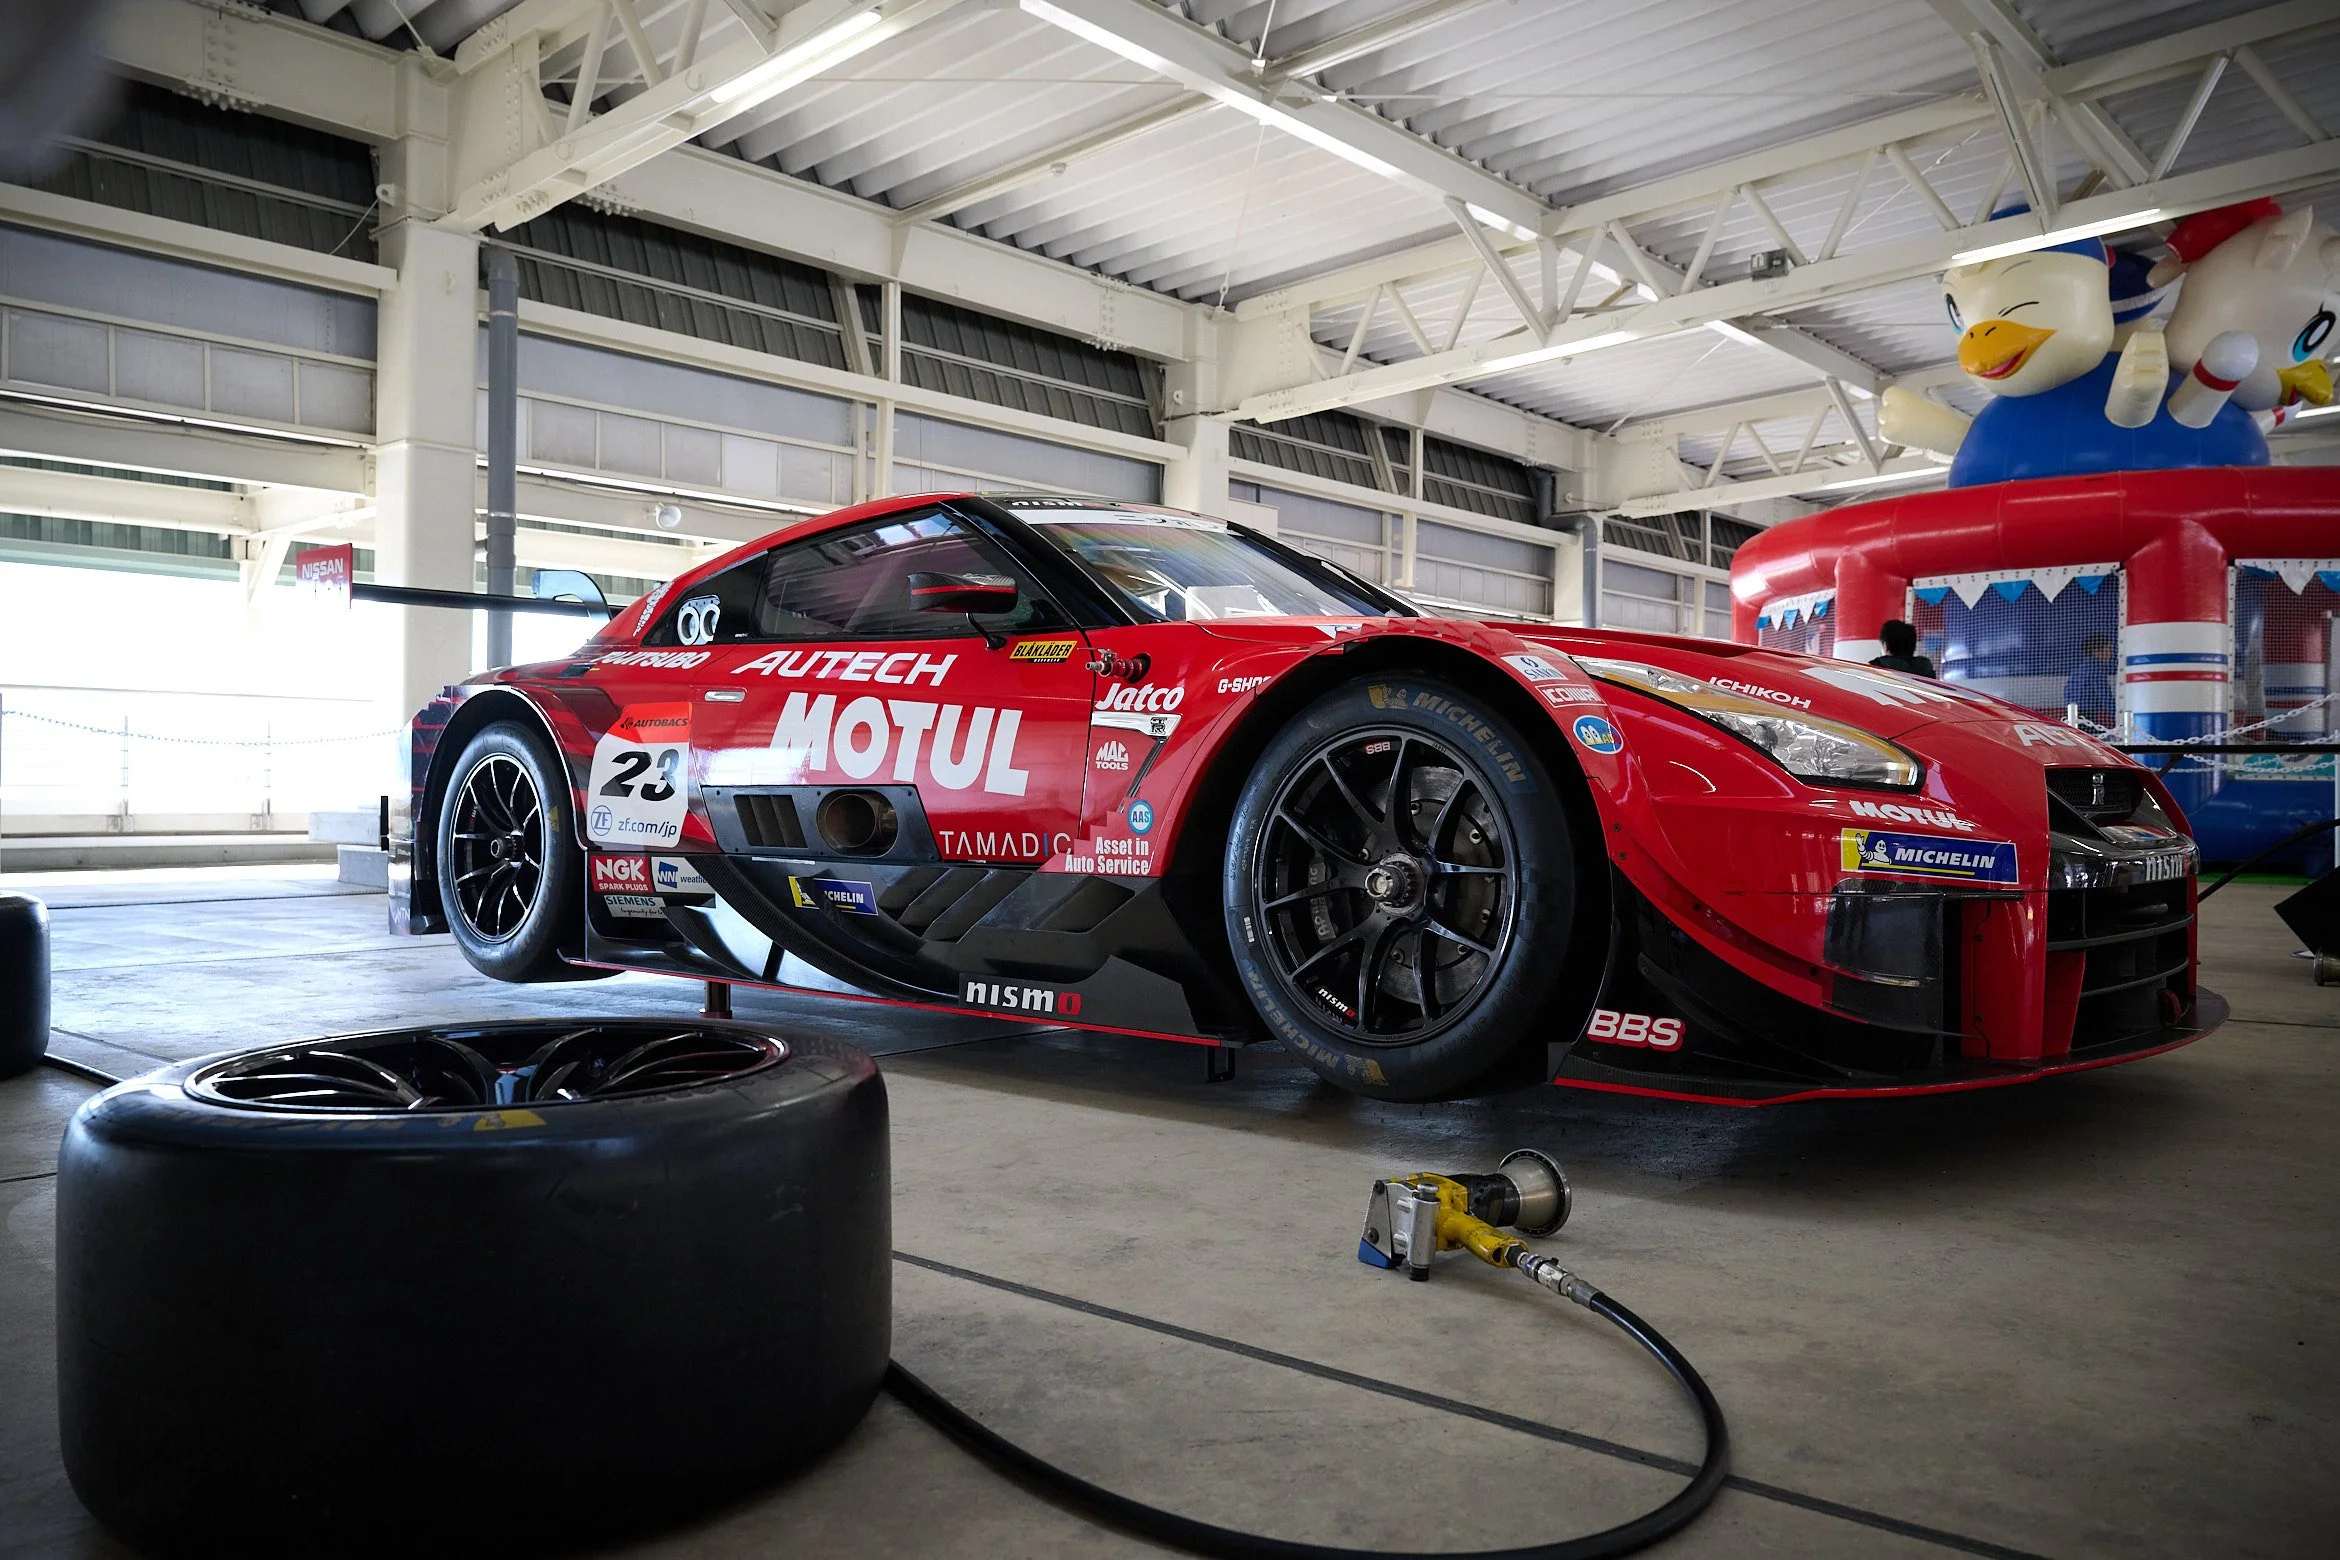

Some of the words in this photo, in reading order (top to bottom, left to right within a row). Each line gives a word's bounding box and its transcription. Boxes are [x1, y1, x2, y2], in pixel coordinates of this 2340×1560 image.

[302, 557, 344, 579] NISSAN
[730, 650, 959, 686] AUTECH
[1217, 675, 1271, 694] G-SHO
[1708, 676, 1812, 709] ICHIKOH
[1095, 683, 1185, 711] Jatco
[634, 717, 689, 728] AUTOBACS
[768, 691, 1031, 797] MOTUL
[1365, 741, 1391, 754] BBS
[1412, 691, 1526, 784] MICHELIN
[1096, 740, 1129, 762] MAC
[599, 748, 680, 802] 23
[1096, 761, 1129, 771] TOOLS
[617, 816, 678, 838] zf.com/jp
[1131, 810, 1150, 824] AAS
[1849, 800, 1974, 833] MOTUL
[1095, 836, 1132, 856] Asset
[1135, 837, 1149, 856] in
[1064, 853, 1095, 874] Auto
[1097, 855, 1150, 876] Service
[1894, 846, 1996, 870] MICHELIN
[595, 858, 645, 882] NGK
[598, 882, 625, 891] SPARK
[625, 883, 649, 892] PLUGS
[823, 890, 865, 904] CHELIN
[606, 896, 656, 906] SIEMENS
[966, 981, 1082, 1016] nismo
[1317, 987, 1357, 1018] nismo
[1246, 969, 1340, 1069] MICHELIN
[1587, 1008, 1683, 1047] BBS
